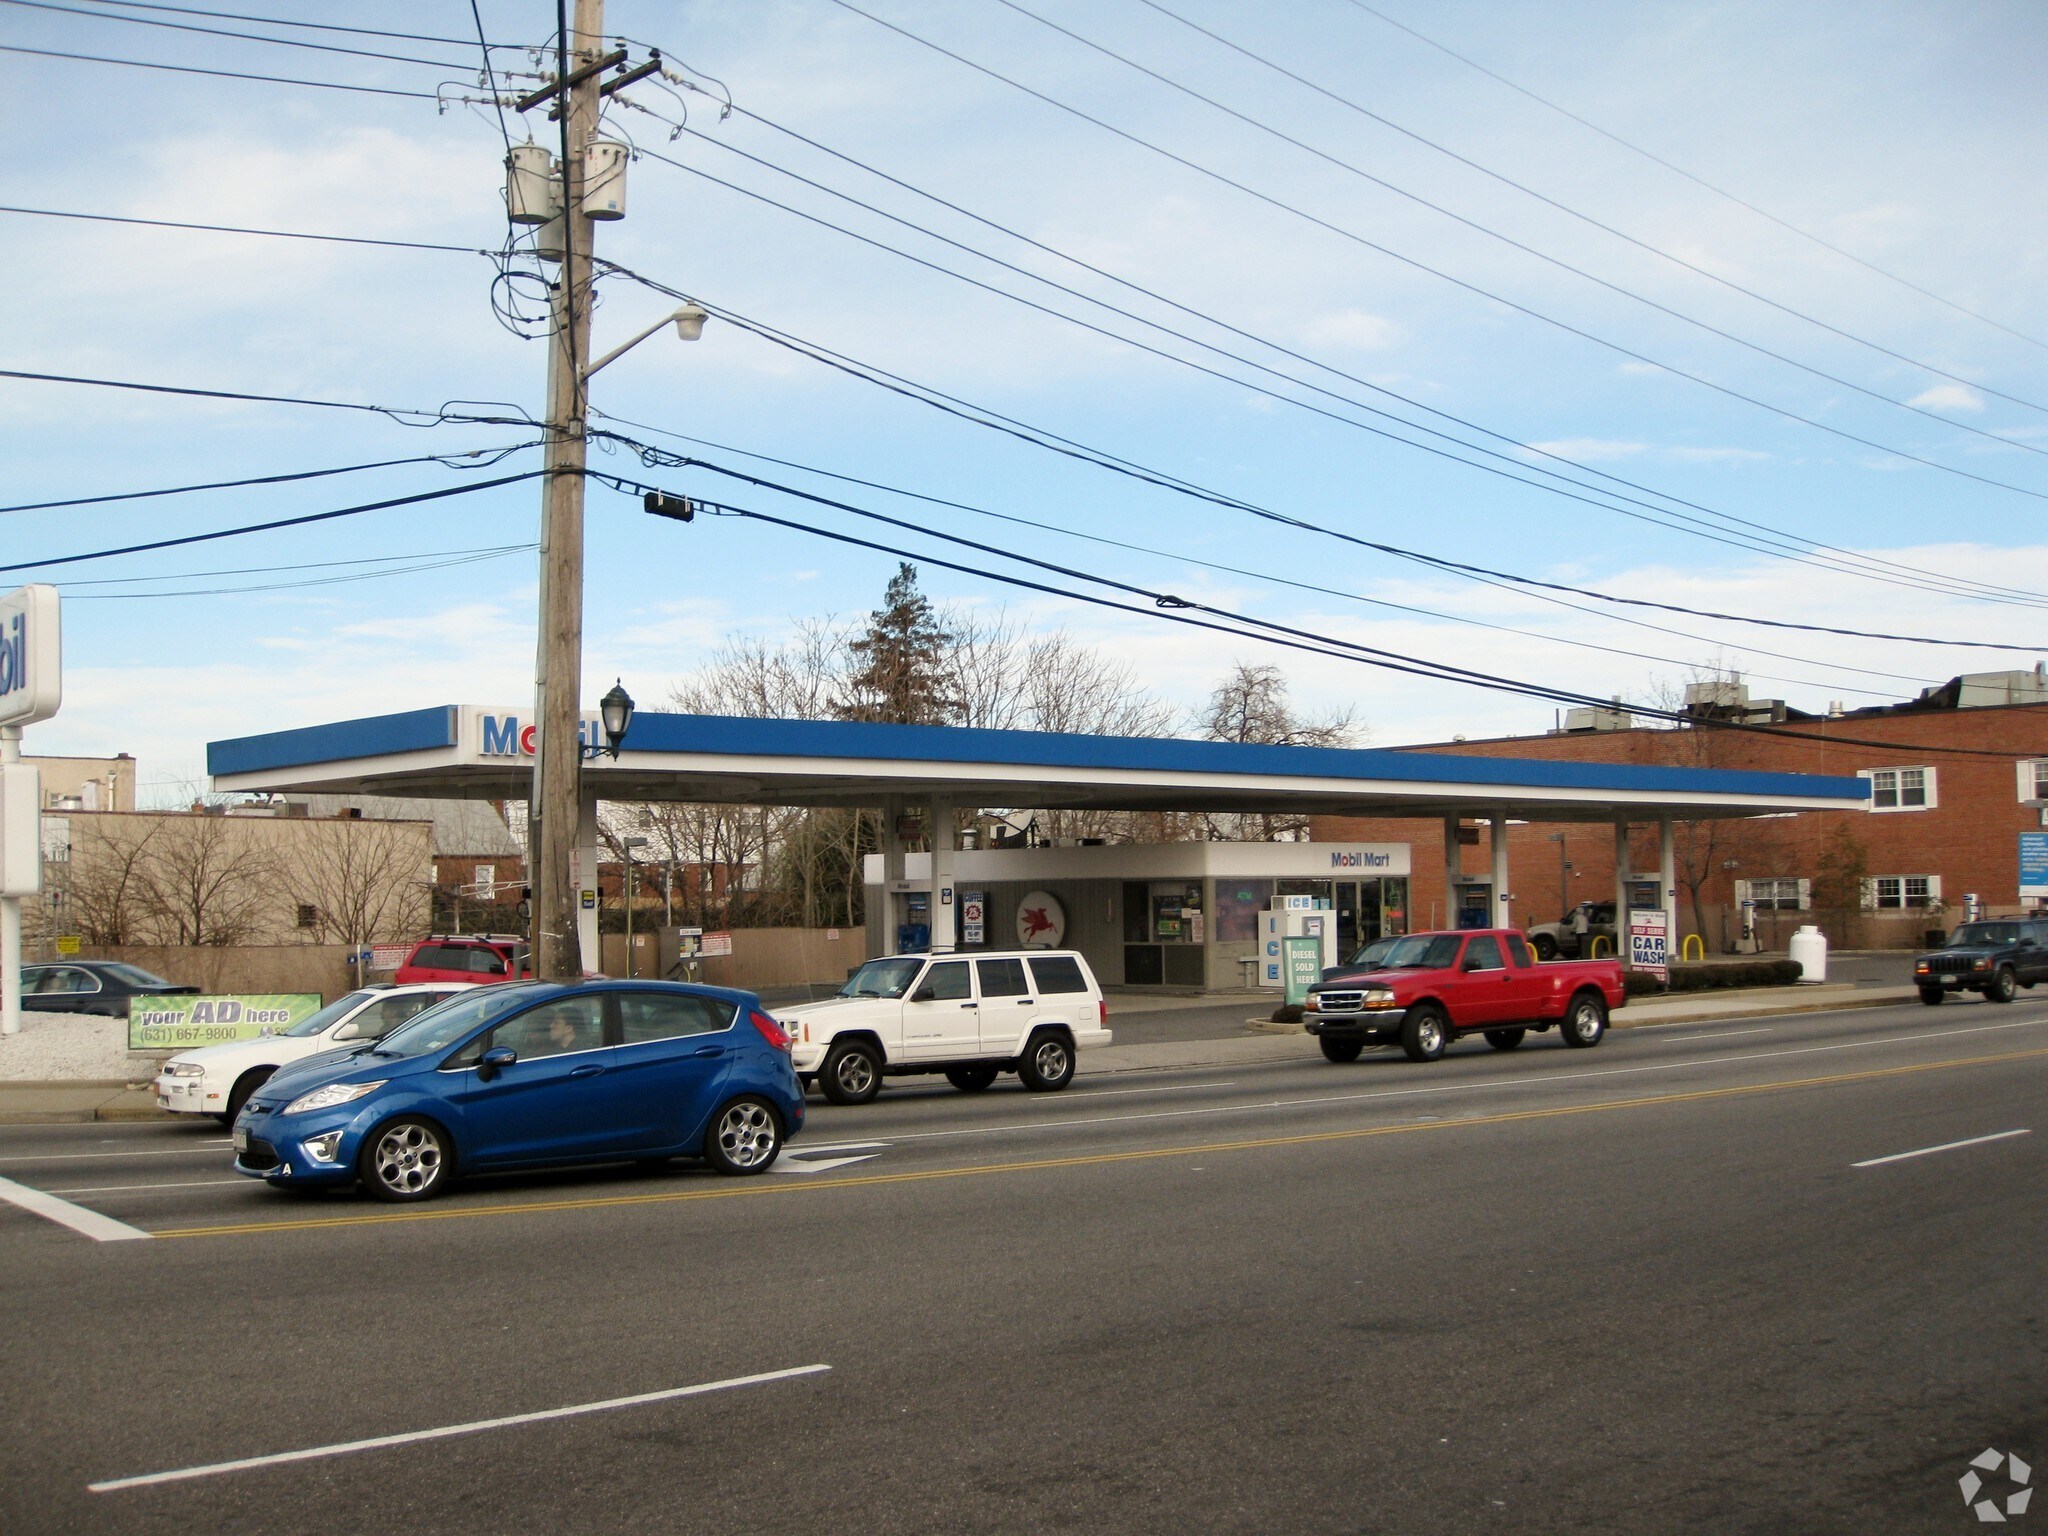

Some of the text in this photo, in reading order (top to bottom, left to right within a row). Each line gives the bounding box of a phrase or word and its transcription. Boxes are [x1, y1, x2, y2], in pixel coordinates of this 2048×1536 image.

[1332, 852, 1390, 868] Mobil Mart
[1288, 897, 1310, 908] ICE
[1267, 917, 1280, 980] ICE
[1633, 936, 1665, 951] CAR
[1292, 950, 1317, 959] DIESEL
[1633, 950, 1665, 964] WASH
[1295, 962, 1315, 972] SOLD
[1296, 975, 1315, 984] HERE
[141, 1001, 289, 1026] your AD here
[140, 1027, 172, 1042] (631)
[176, 1027, 237, 1041] 667-9800
